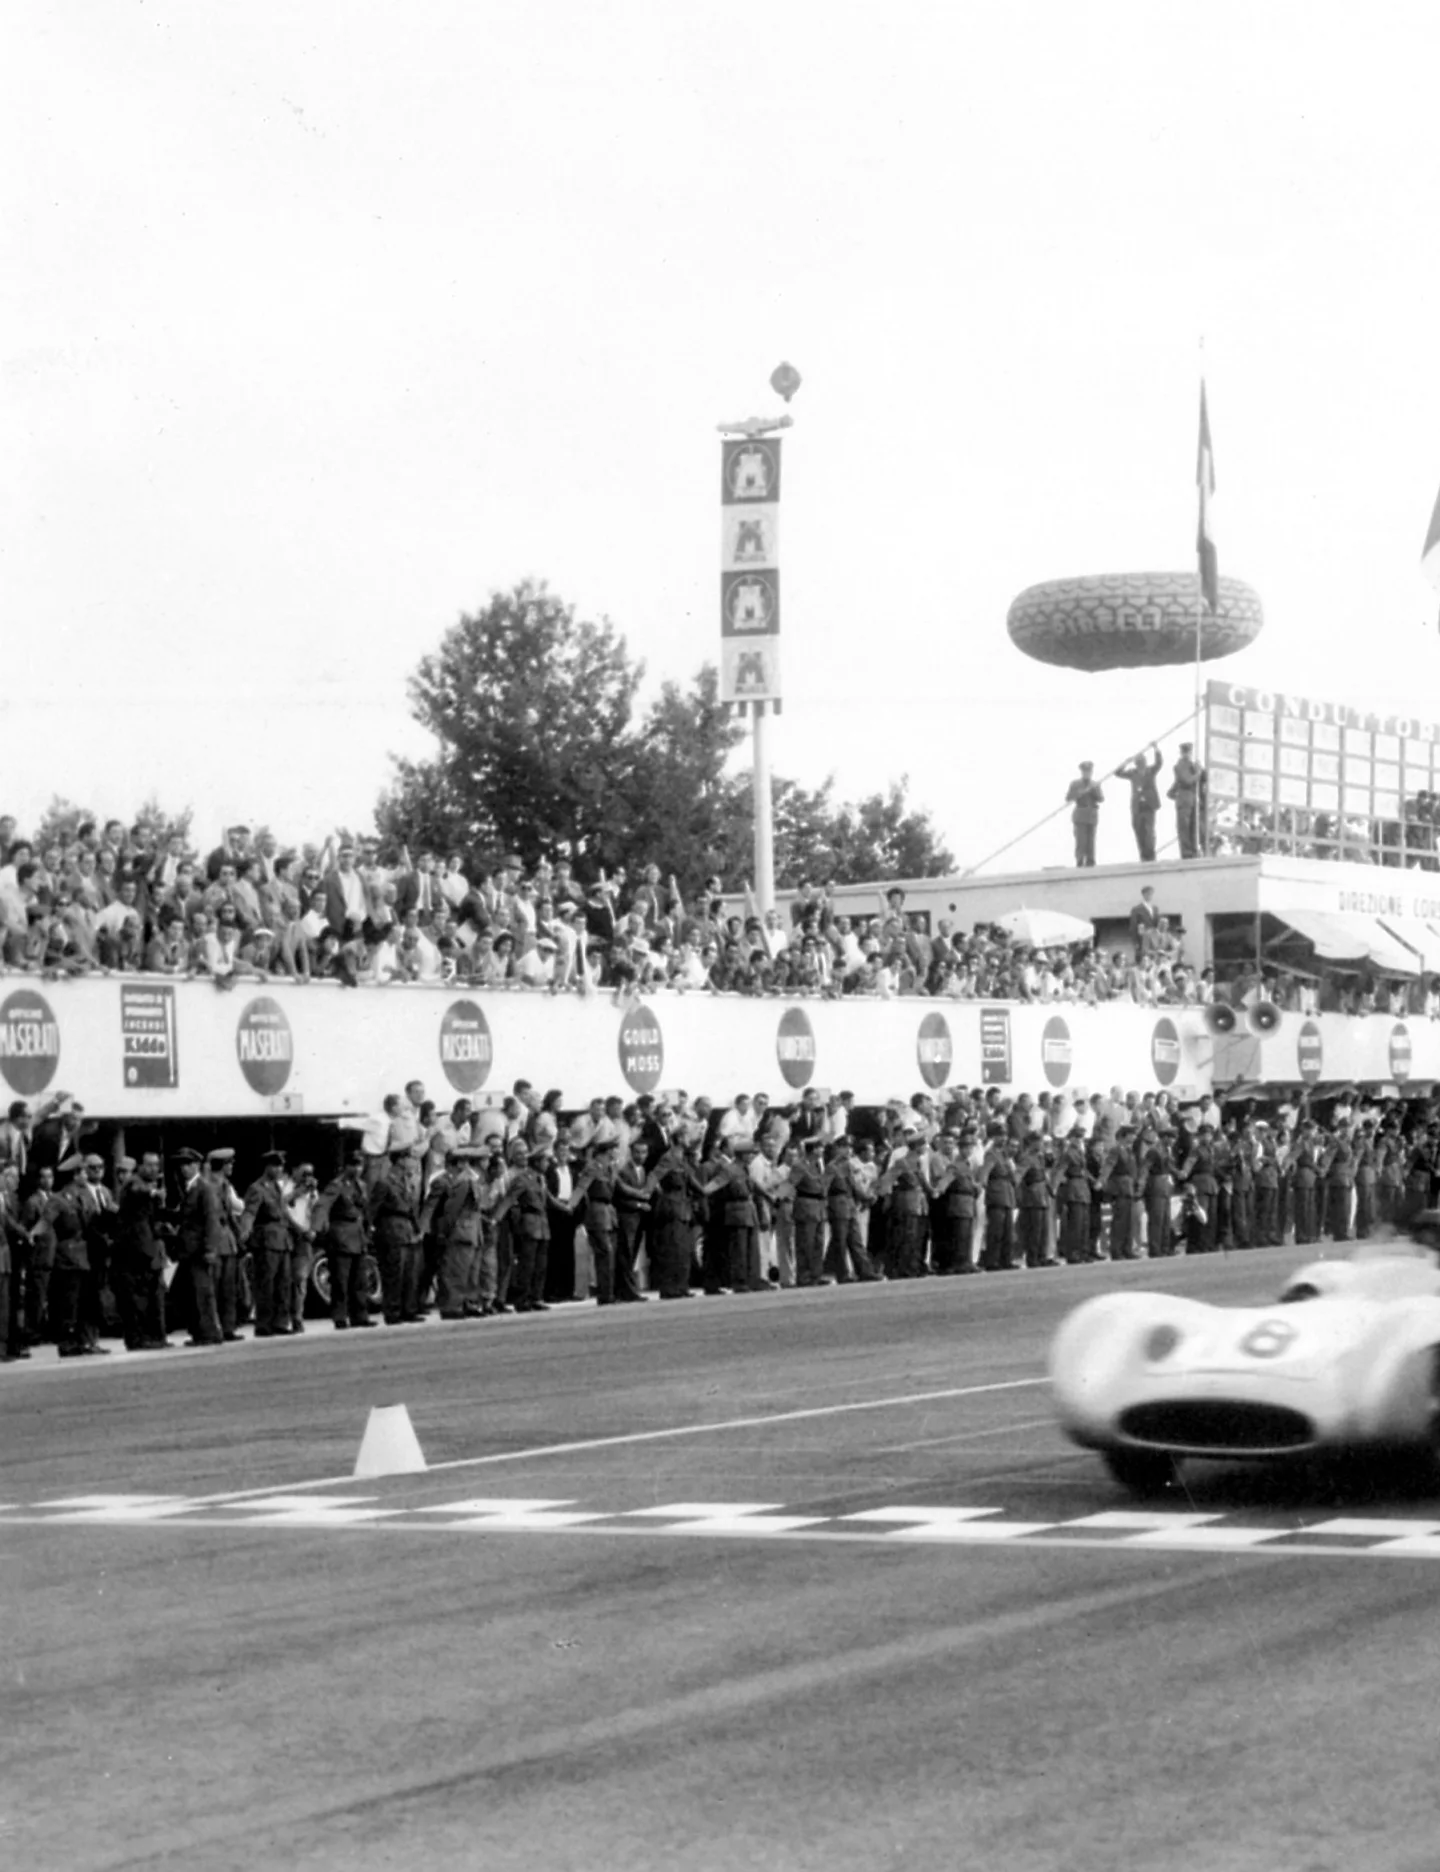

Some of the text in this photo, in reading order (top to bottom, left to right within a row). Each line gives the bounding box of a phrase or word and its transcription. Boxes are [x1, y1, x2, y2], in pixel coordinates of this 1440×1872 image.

[1338, 890, 1403, 917] DIREZIONE
[623, 1028, 659, 1045] GOULD
[626, 1055, 660, 1072] MOSS
